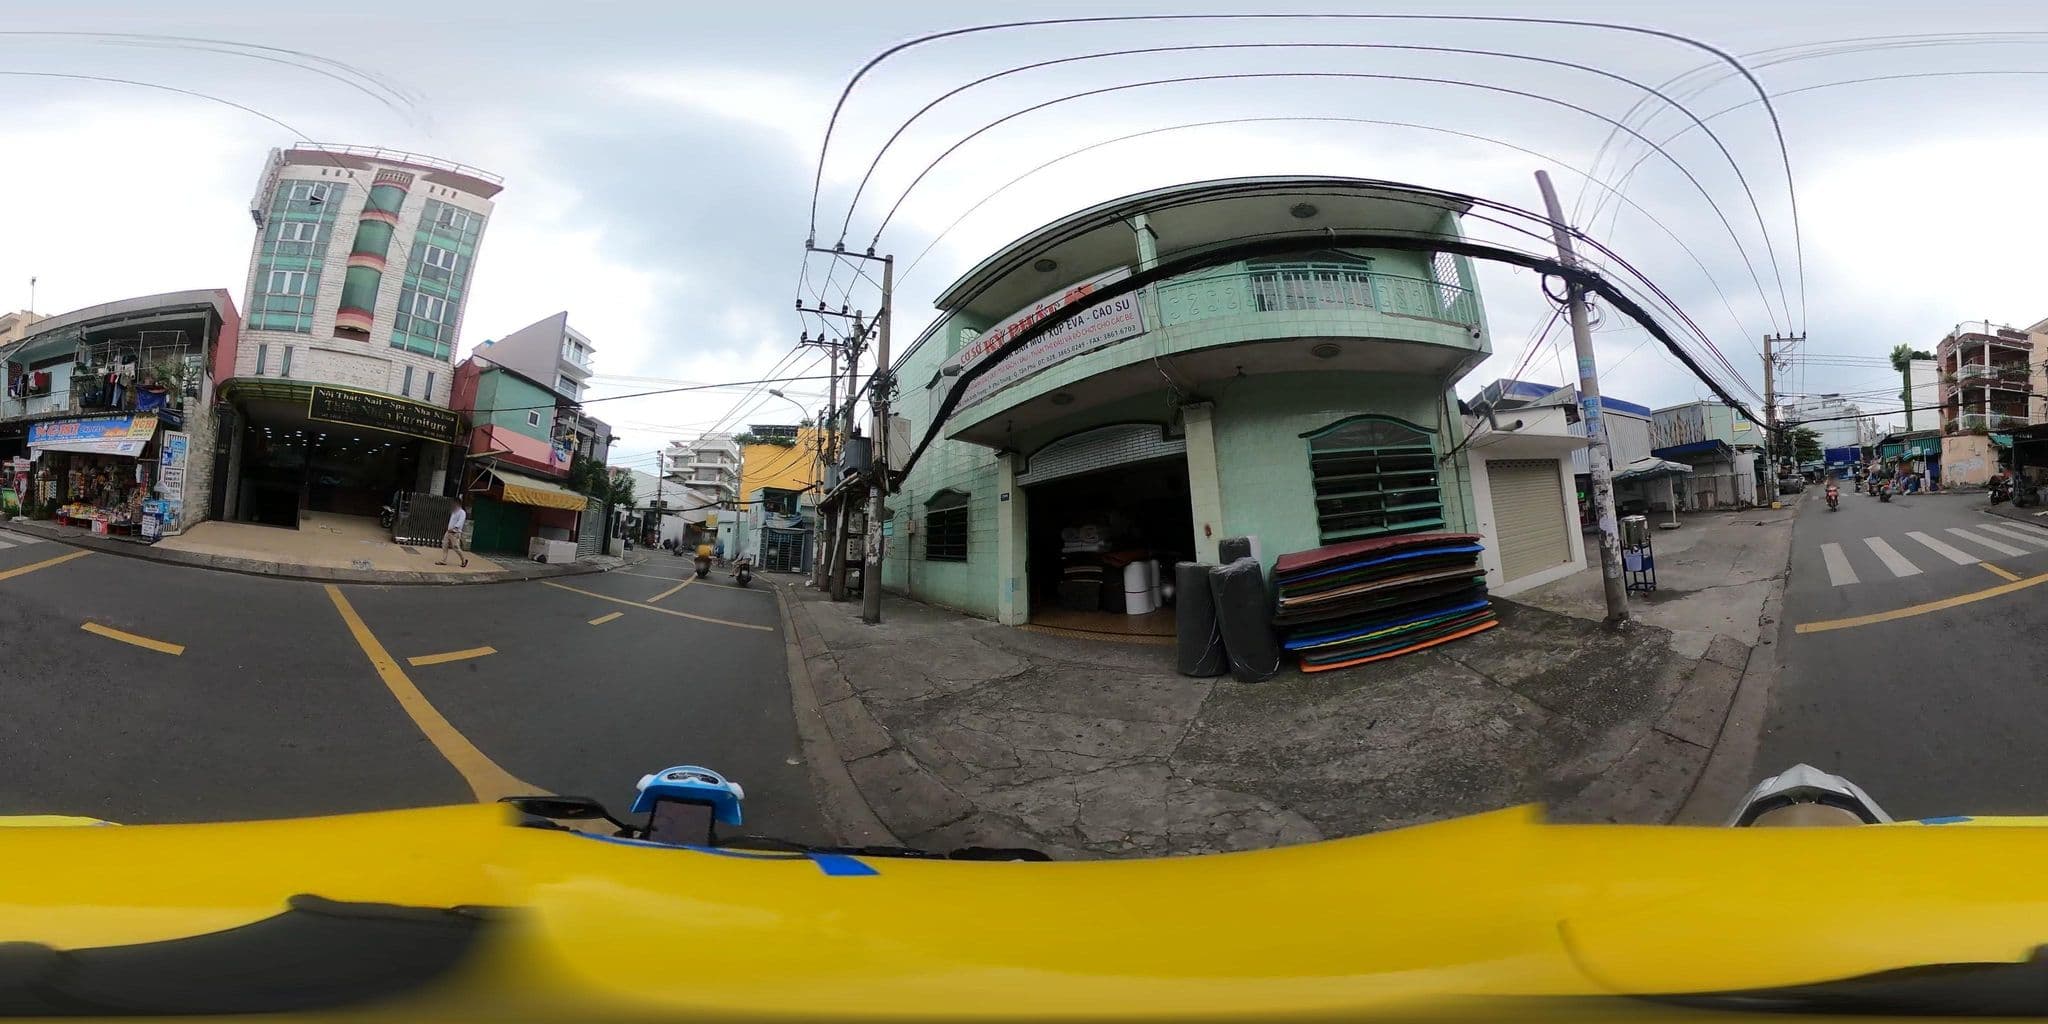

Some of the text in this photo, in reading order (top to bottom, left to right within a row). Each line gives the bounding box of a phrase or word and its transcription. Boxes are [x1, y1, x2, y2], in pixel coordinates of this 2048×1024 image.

[1067, 315, 1085, 330] EVA
[1092, 304, 1113, 320] CAO
[1115, 298, 1130, 312] SU
[364, 395, 382, 406] Nail
[390, 401, 406, 412] Spa
[395, 412, 448, 432] Furniture
